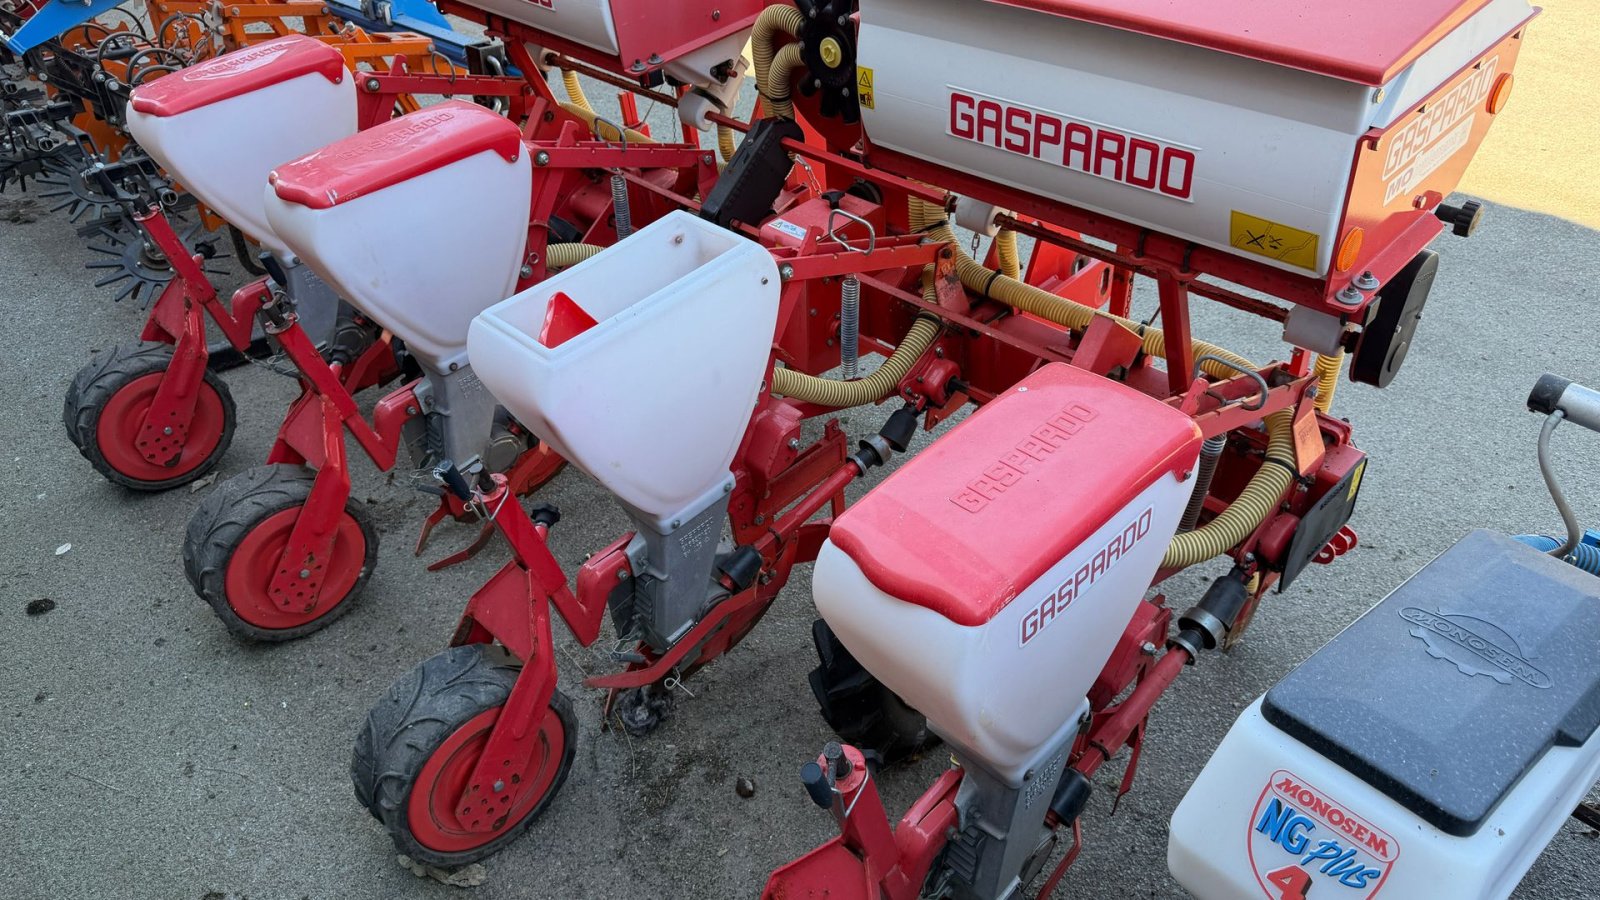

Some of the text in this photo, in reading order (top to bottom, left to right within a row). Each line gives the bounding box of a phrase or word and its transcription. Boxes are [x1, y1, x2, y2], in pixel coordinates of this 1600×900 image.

[950, 92, 1195, 199] GASPARDO
[1385, 61, 1495, 178] GASPARDO
[948, 401, 1100, 514] GASPARDO
[1021, 507, 1152, 645] GASPARDO
[1405, 611, 1541, 686] MONOSEM
[1256, 796, 1316, 855] NG
[1275, 777, 1388, 858] MONOSEM
[1265, 864, 1313, 900] 4
